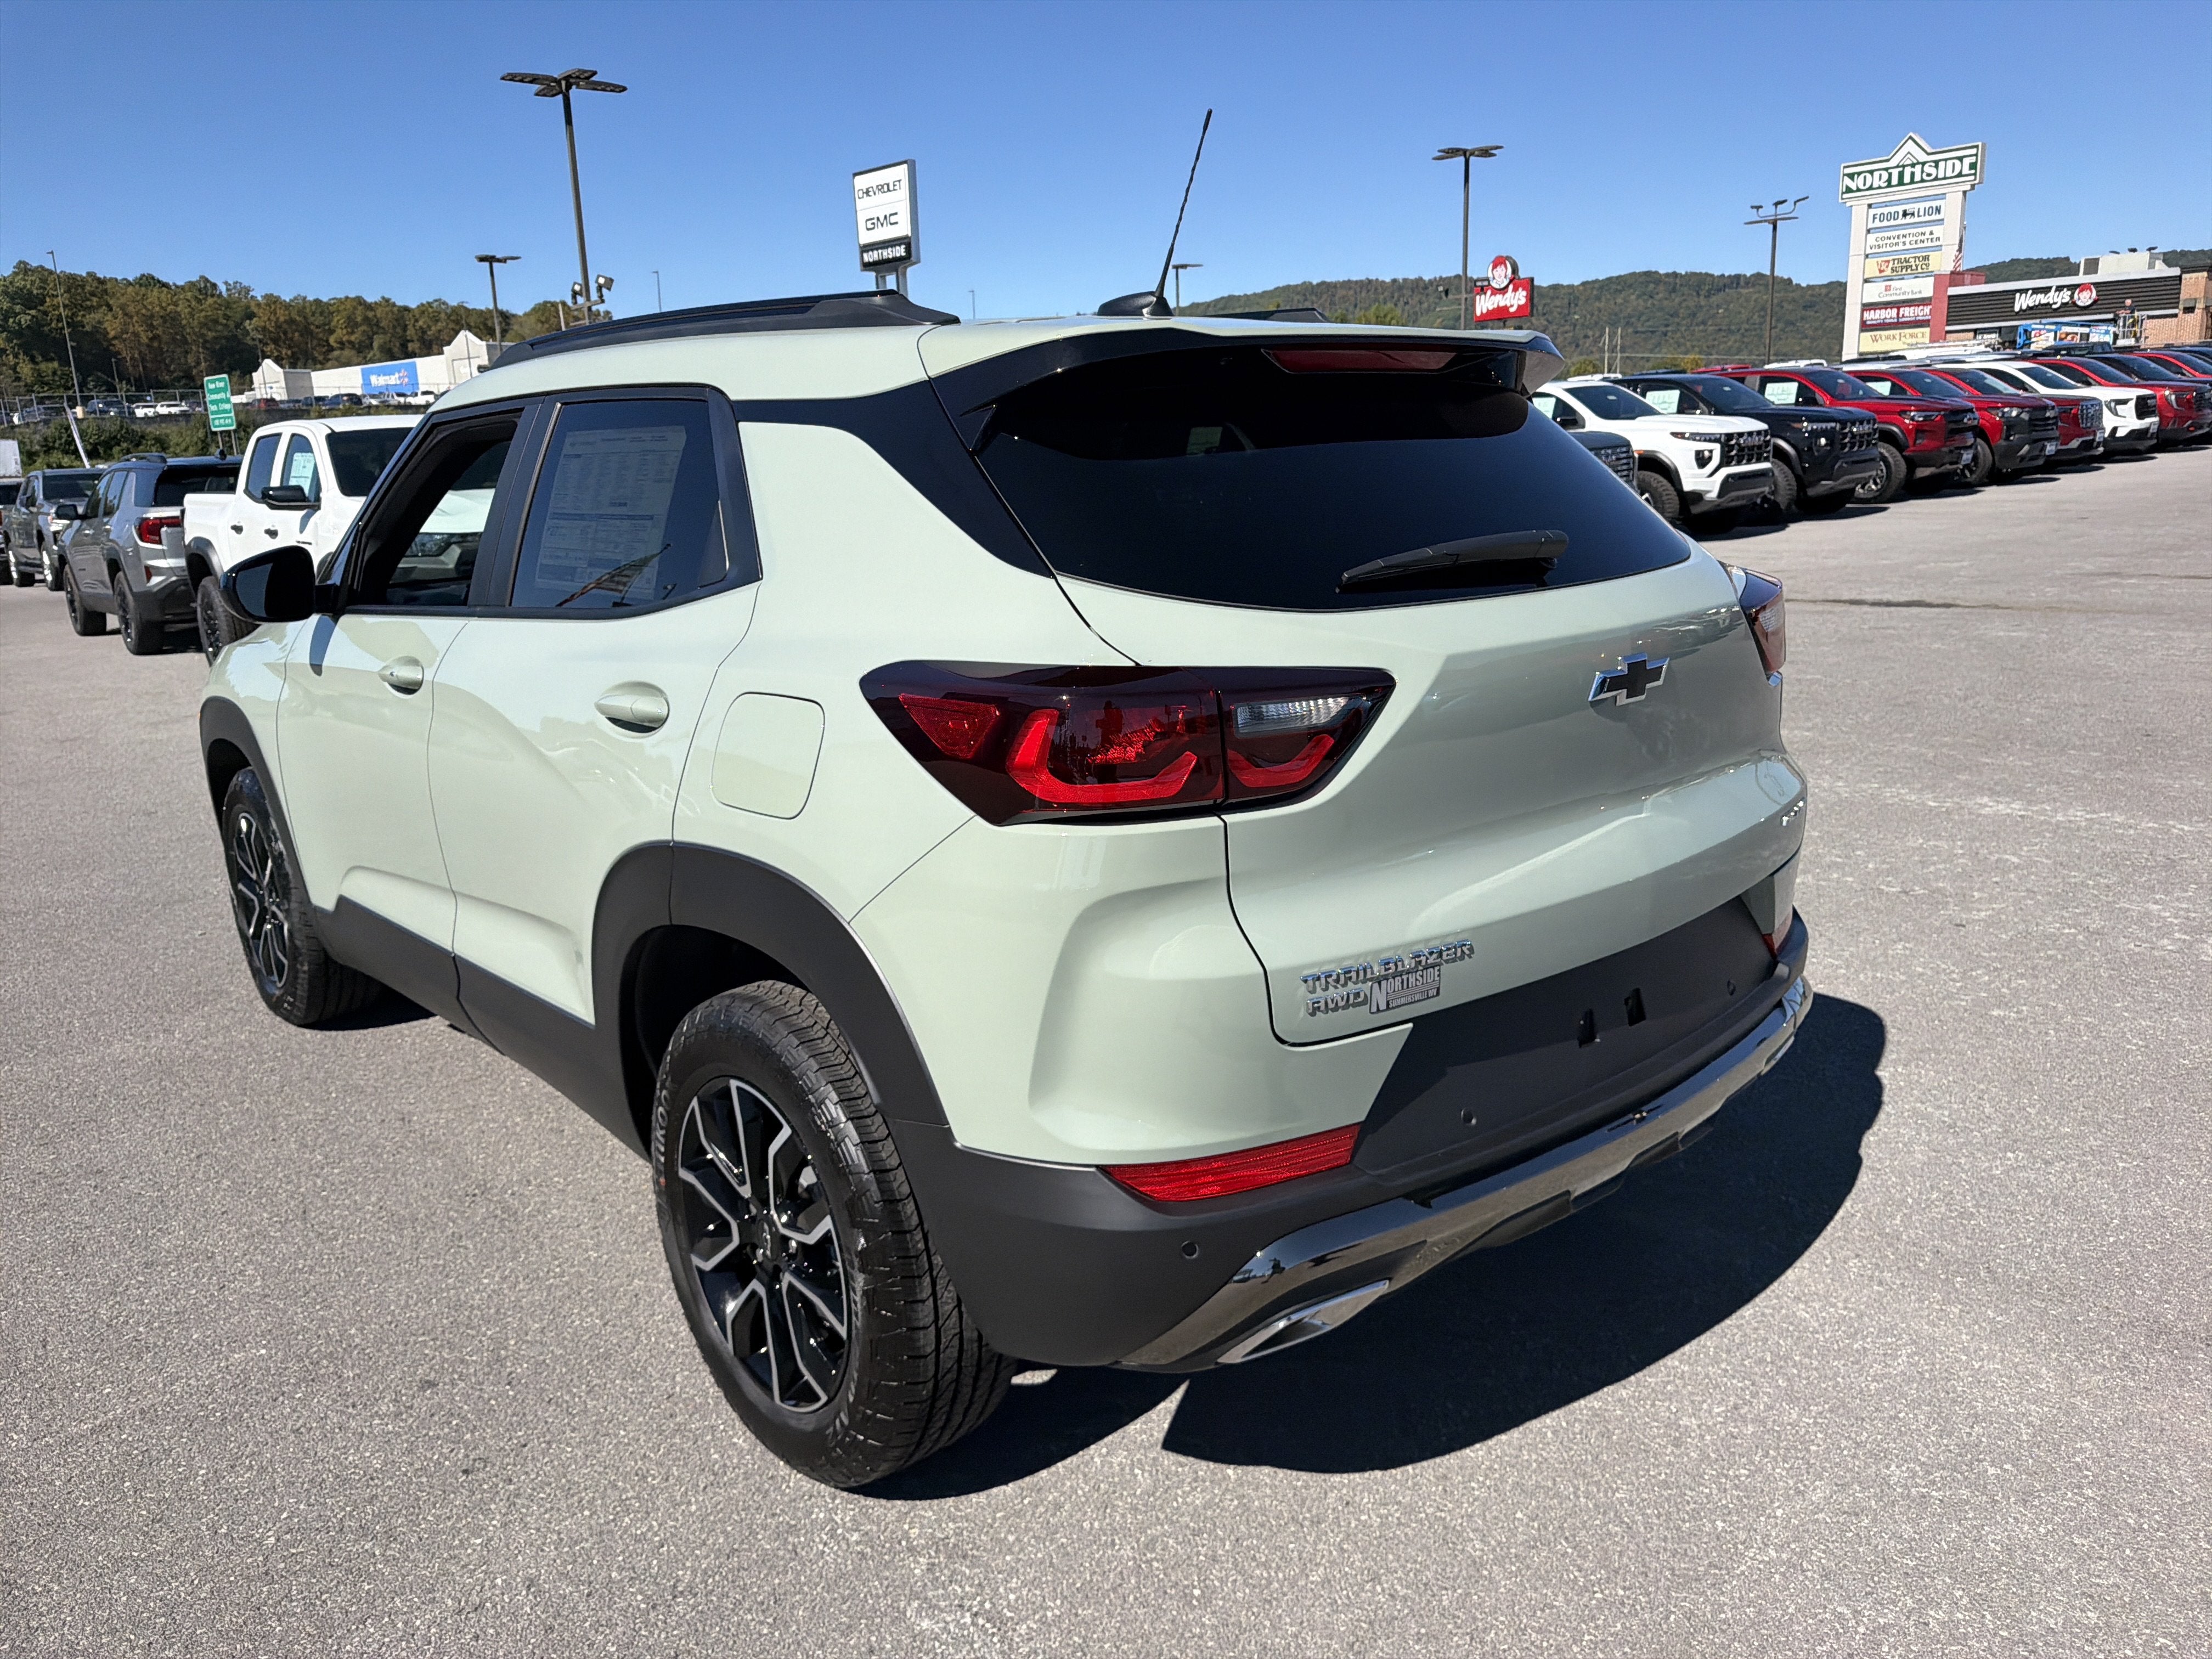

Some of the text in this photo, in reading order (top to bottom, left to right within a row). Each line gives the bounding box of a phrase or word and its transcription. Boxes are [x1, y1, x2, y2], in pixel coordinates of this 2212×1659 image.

[1843, 156, 1977, 192] NORTHSIDE
[857, 179, 902, 200] CHEVROLET
[865, 212, 899, 231] GMC
[1872, 205, 1942, 224] FOOD LION
[1869, 236, 1940, 250] VISITOR'S CENTER
[1875, 231, 1926, 242] CONVENTION
[862, 245, 906, 263] NORTHSIDE
[1891, 255, 1930, 266] TRACTOR
[1891, 263, 1920, 274] SUPPLY
[1475, 283, 1527, 317] Wendy's
[2014, 285, 2072, 312] Wendy's
[1863, 308, 1898, 321] HARBOR
[1870, 331, 1927, 343] WORK FORCE
[1300, 939, 1473, 992] TRAILBLAZER
[1371, 966, 1440, 1012] NORTHSIDE
[1389, 988, 1437, 1008] SUMMERSVILLE WV
[1307, 989, 1365, 1014] AWD
